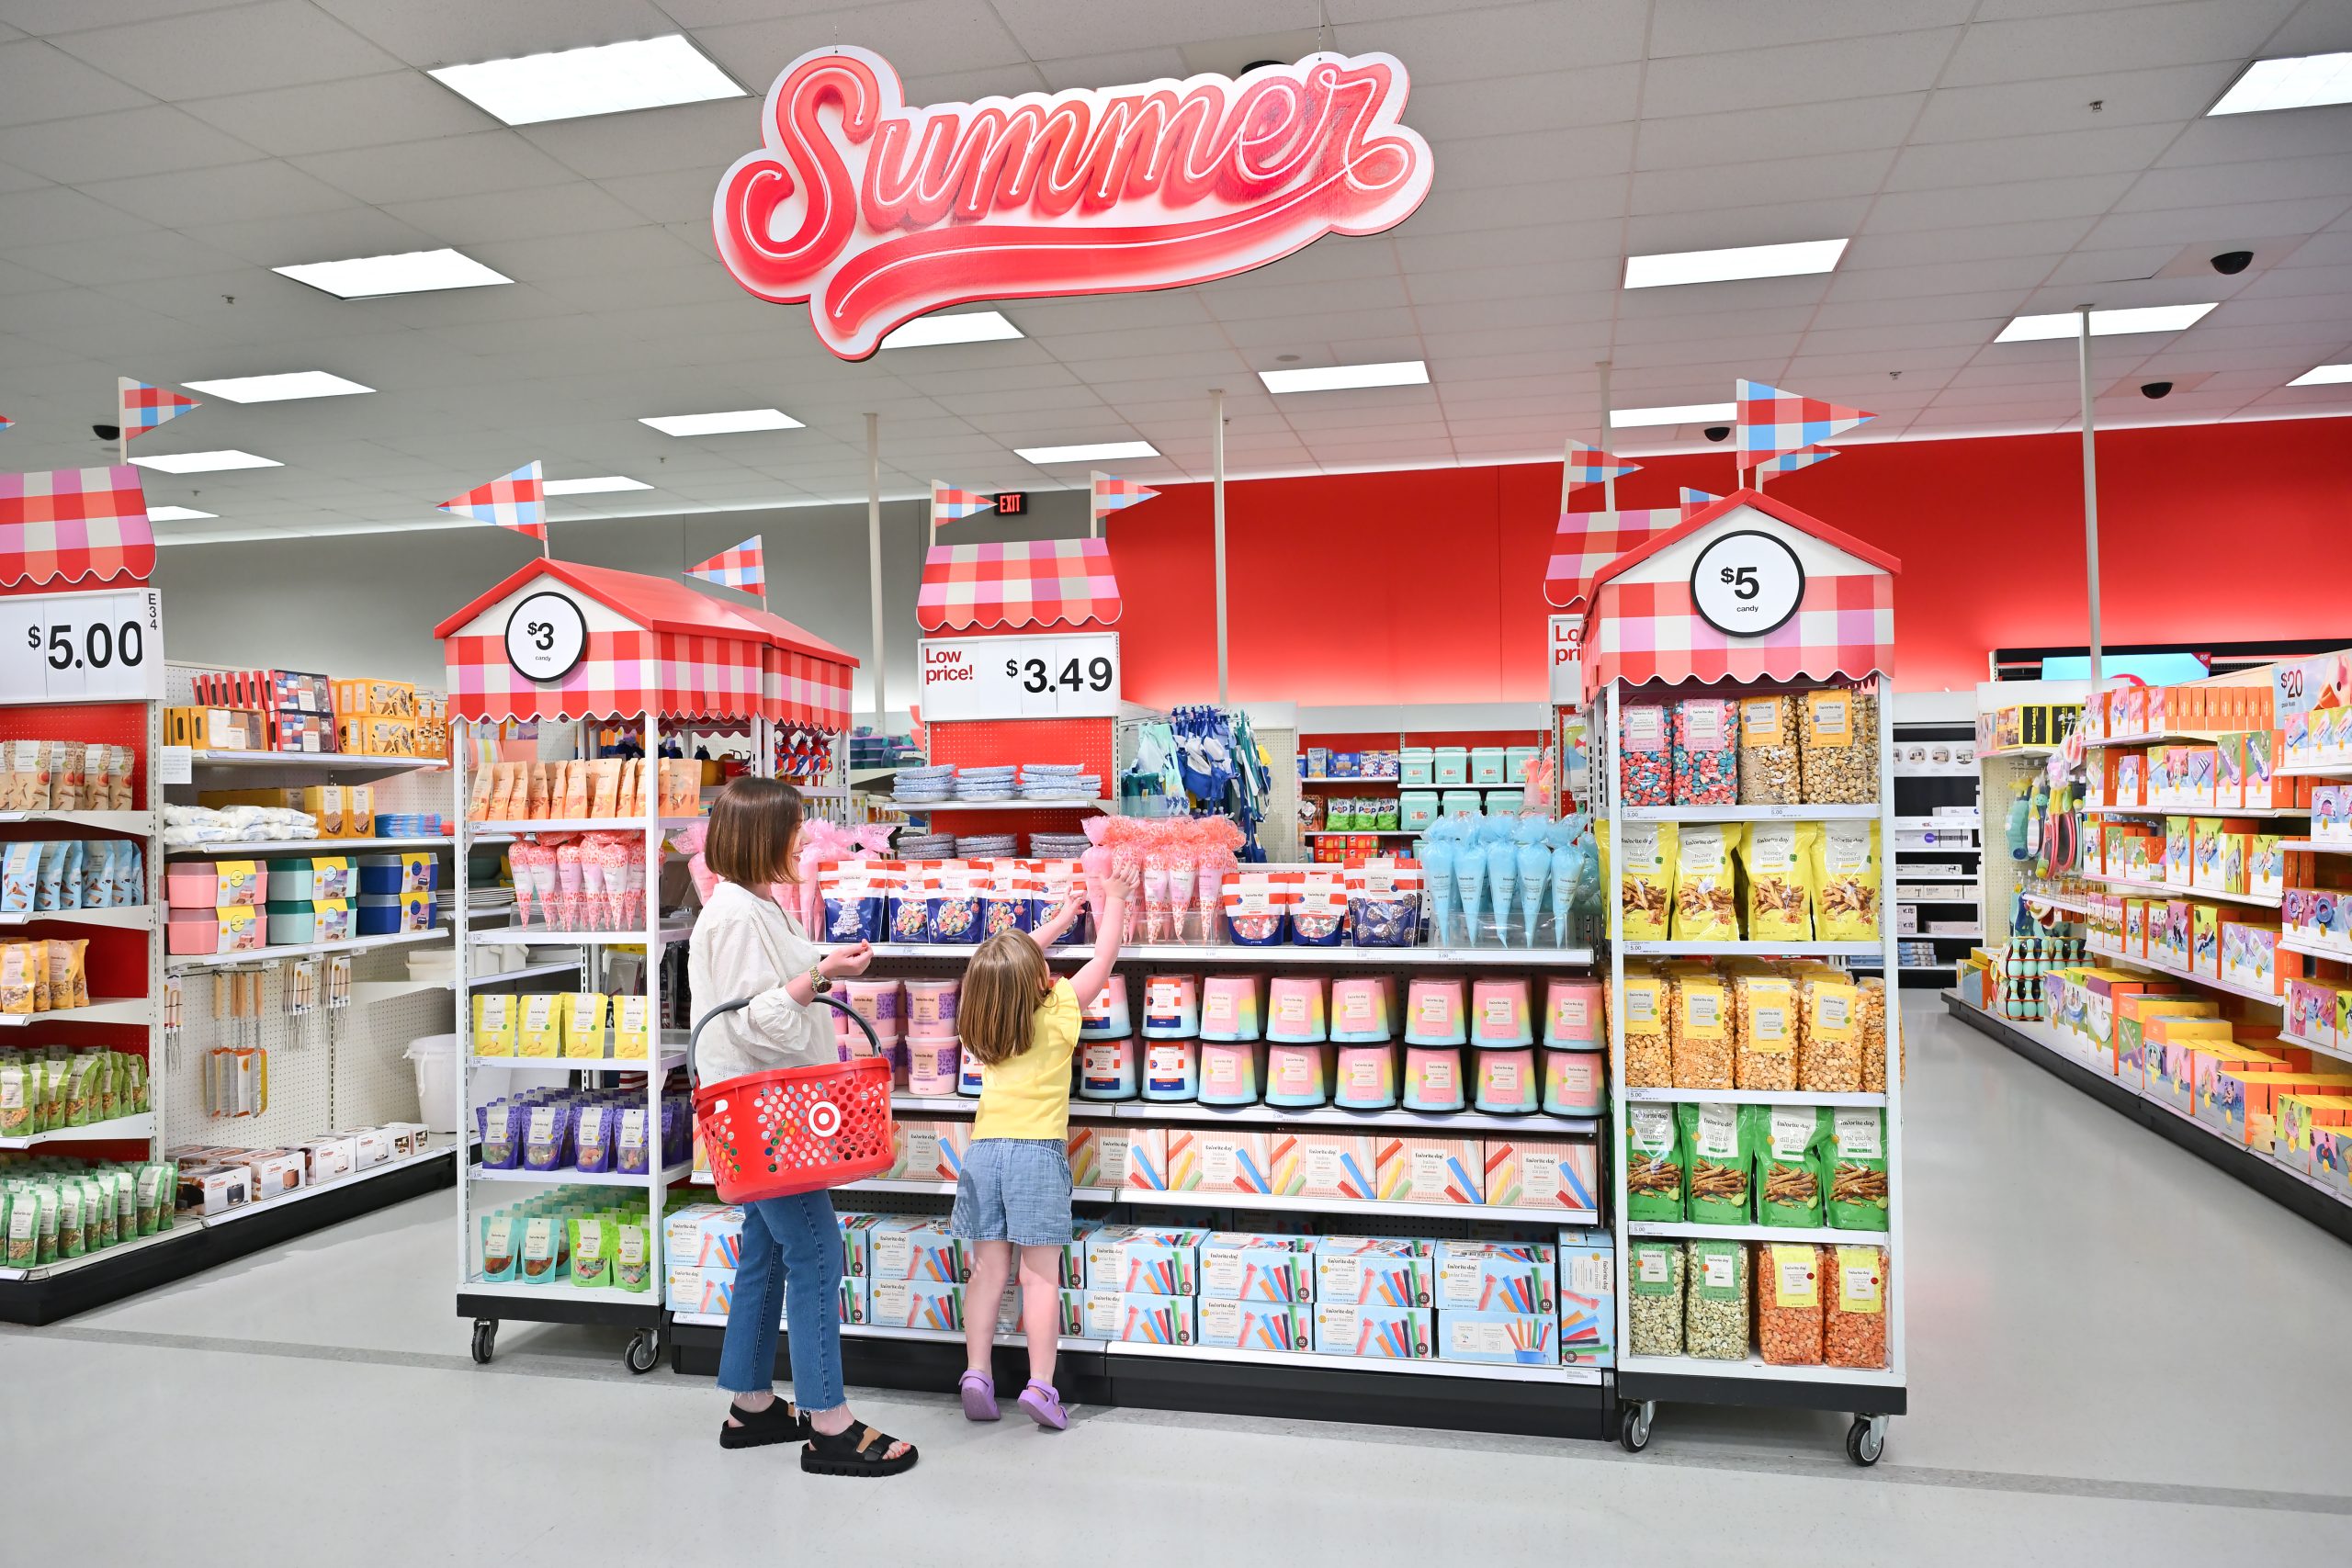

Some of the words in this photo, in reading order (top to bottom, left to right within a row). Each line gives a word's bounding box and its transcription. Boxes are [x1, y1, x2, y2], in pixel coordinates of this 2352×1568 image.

[722, 53, 1413, 336] Summer
[1000, 494, 1021, 513] EXIT
[1720, 567, 1760, 600] $5
[1736, 604, 1758, 613] candy
[28, 621, 143, 671] $5.00
[526, 621, 555, 650] $3
[1555, 625, 1578, 643] Lo
[925, 648, 962, 664] Low
[1555, 646, 1581, 666] pri
[925, 664, 974, 685] price!
[1006, 657, 1113, 694] $3.49
[2280, 669, 2303, 698] $20
